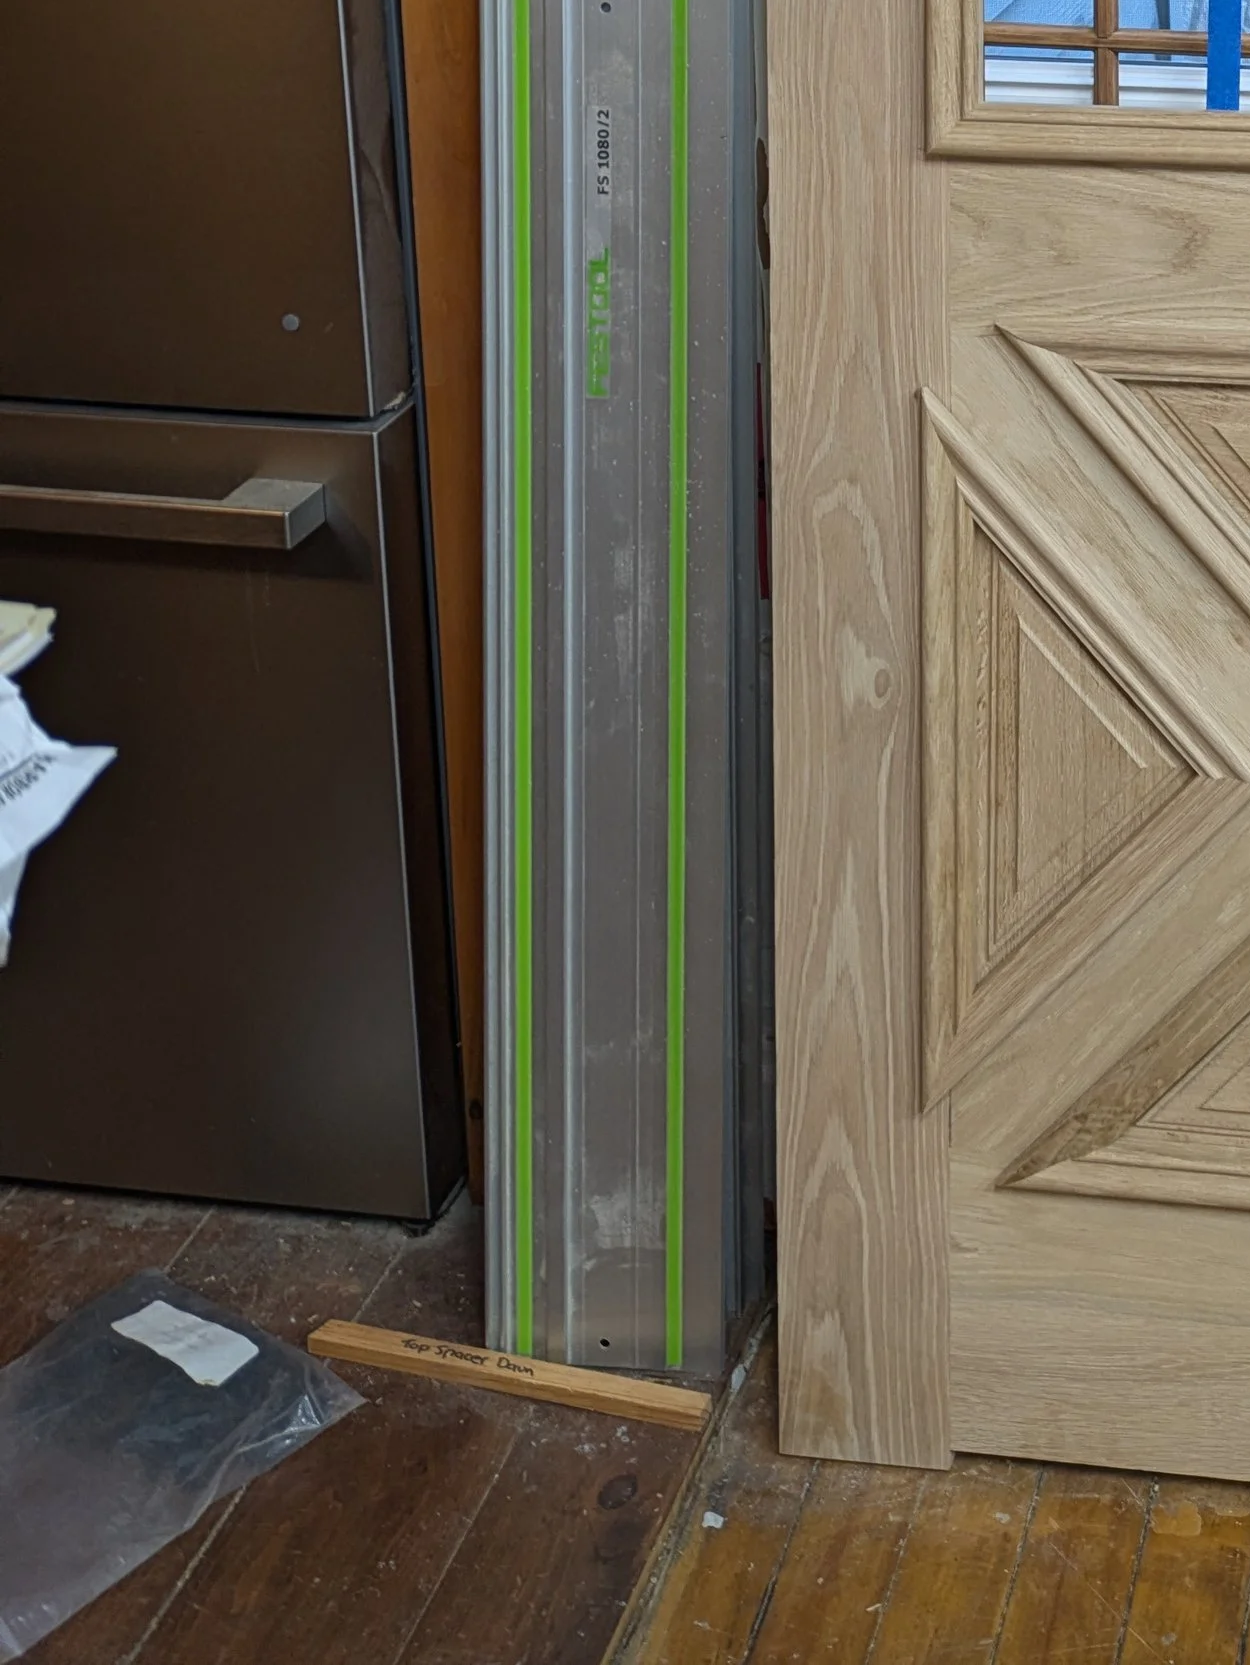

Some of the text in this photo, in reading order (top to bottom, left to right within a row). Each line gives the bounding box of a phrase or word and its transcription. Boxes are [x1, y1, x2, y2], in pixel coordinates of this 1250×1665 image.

[597, 109, 610, 195] FS 1080/2
[434, 1344, 489, 1366] Spacer
